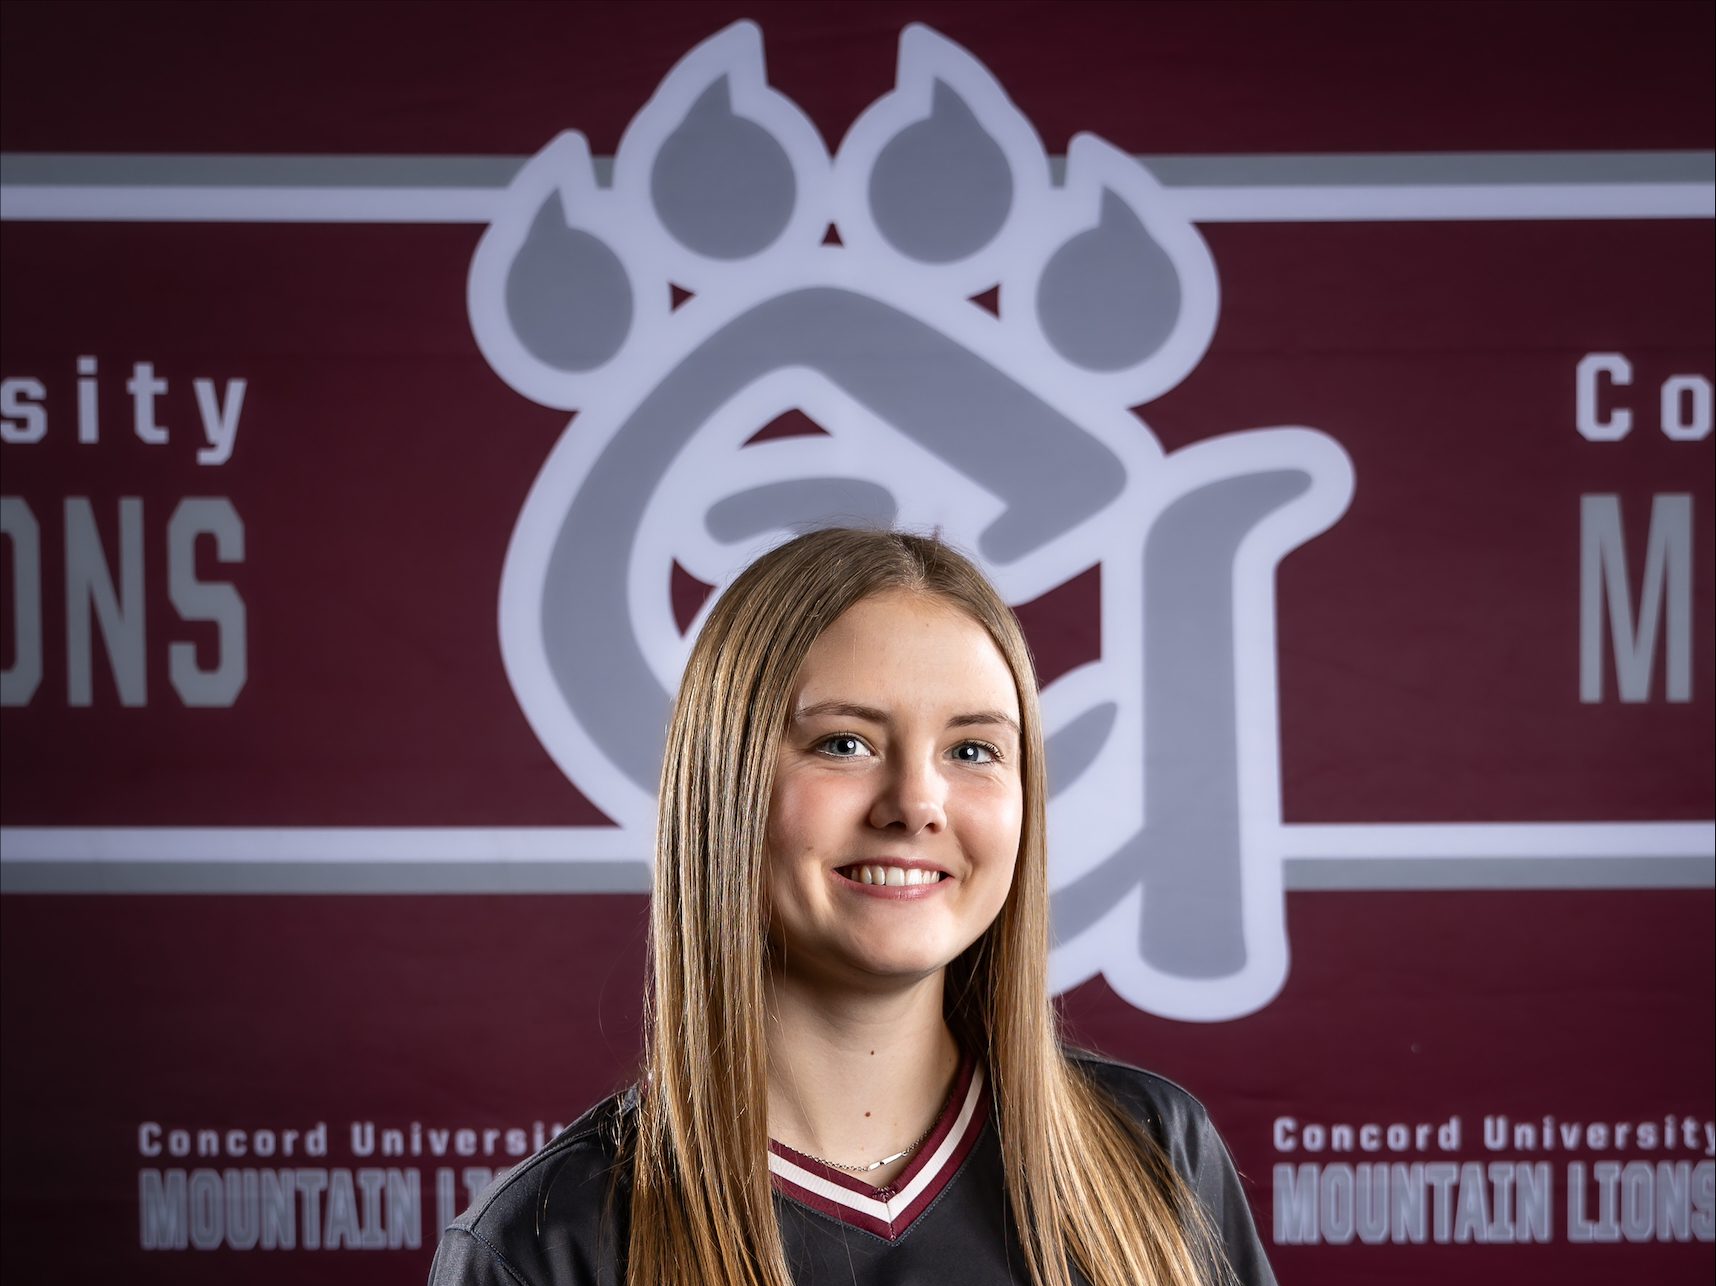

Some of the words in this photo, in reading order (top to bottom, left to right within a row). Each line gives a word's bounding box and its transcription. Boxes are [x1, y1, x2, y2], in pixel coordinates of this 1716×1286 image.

[138, 1121, 328, 1157] Concord
[1273, 1116, 1461, 1152] Concord
[139, 1167, 422, 1250] MOUNTAIN
[1272, 1161, 1553, 1244] MOUNTAIN
[1566, 1160, 1714, 1243] LIONS
